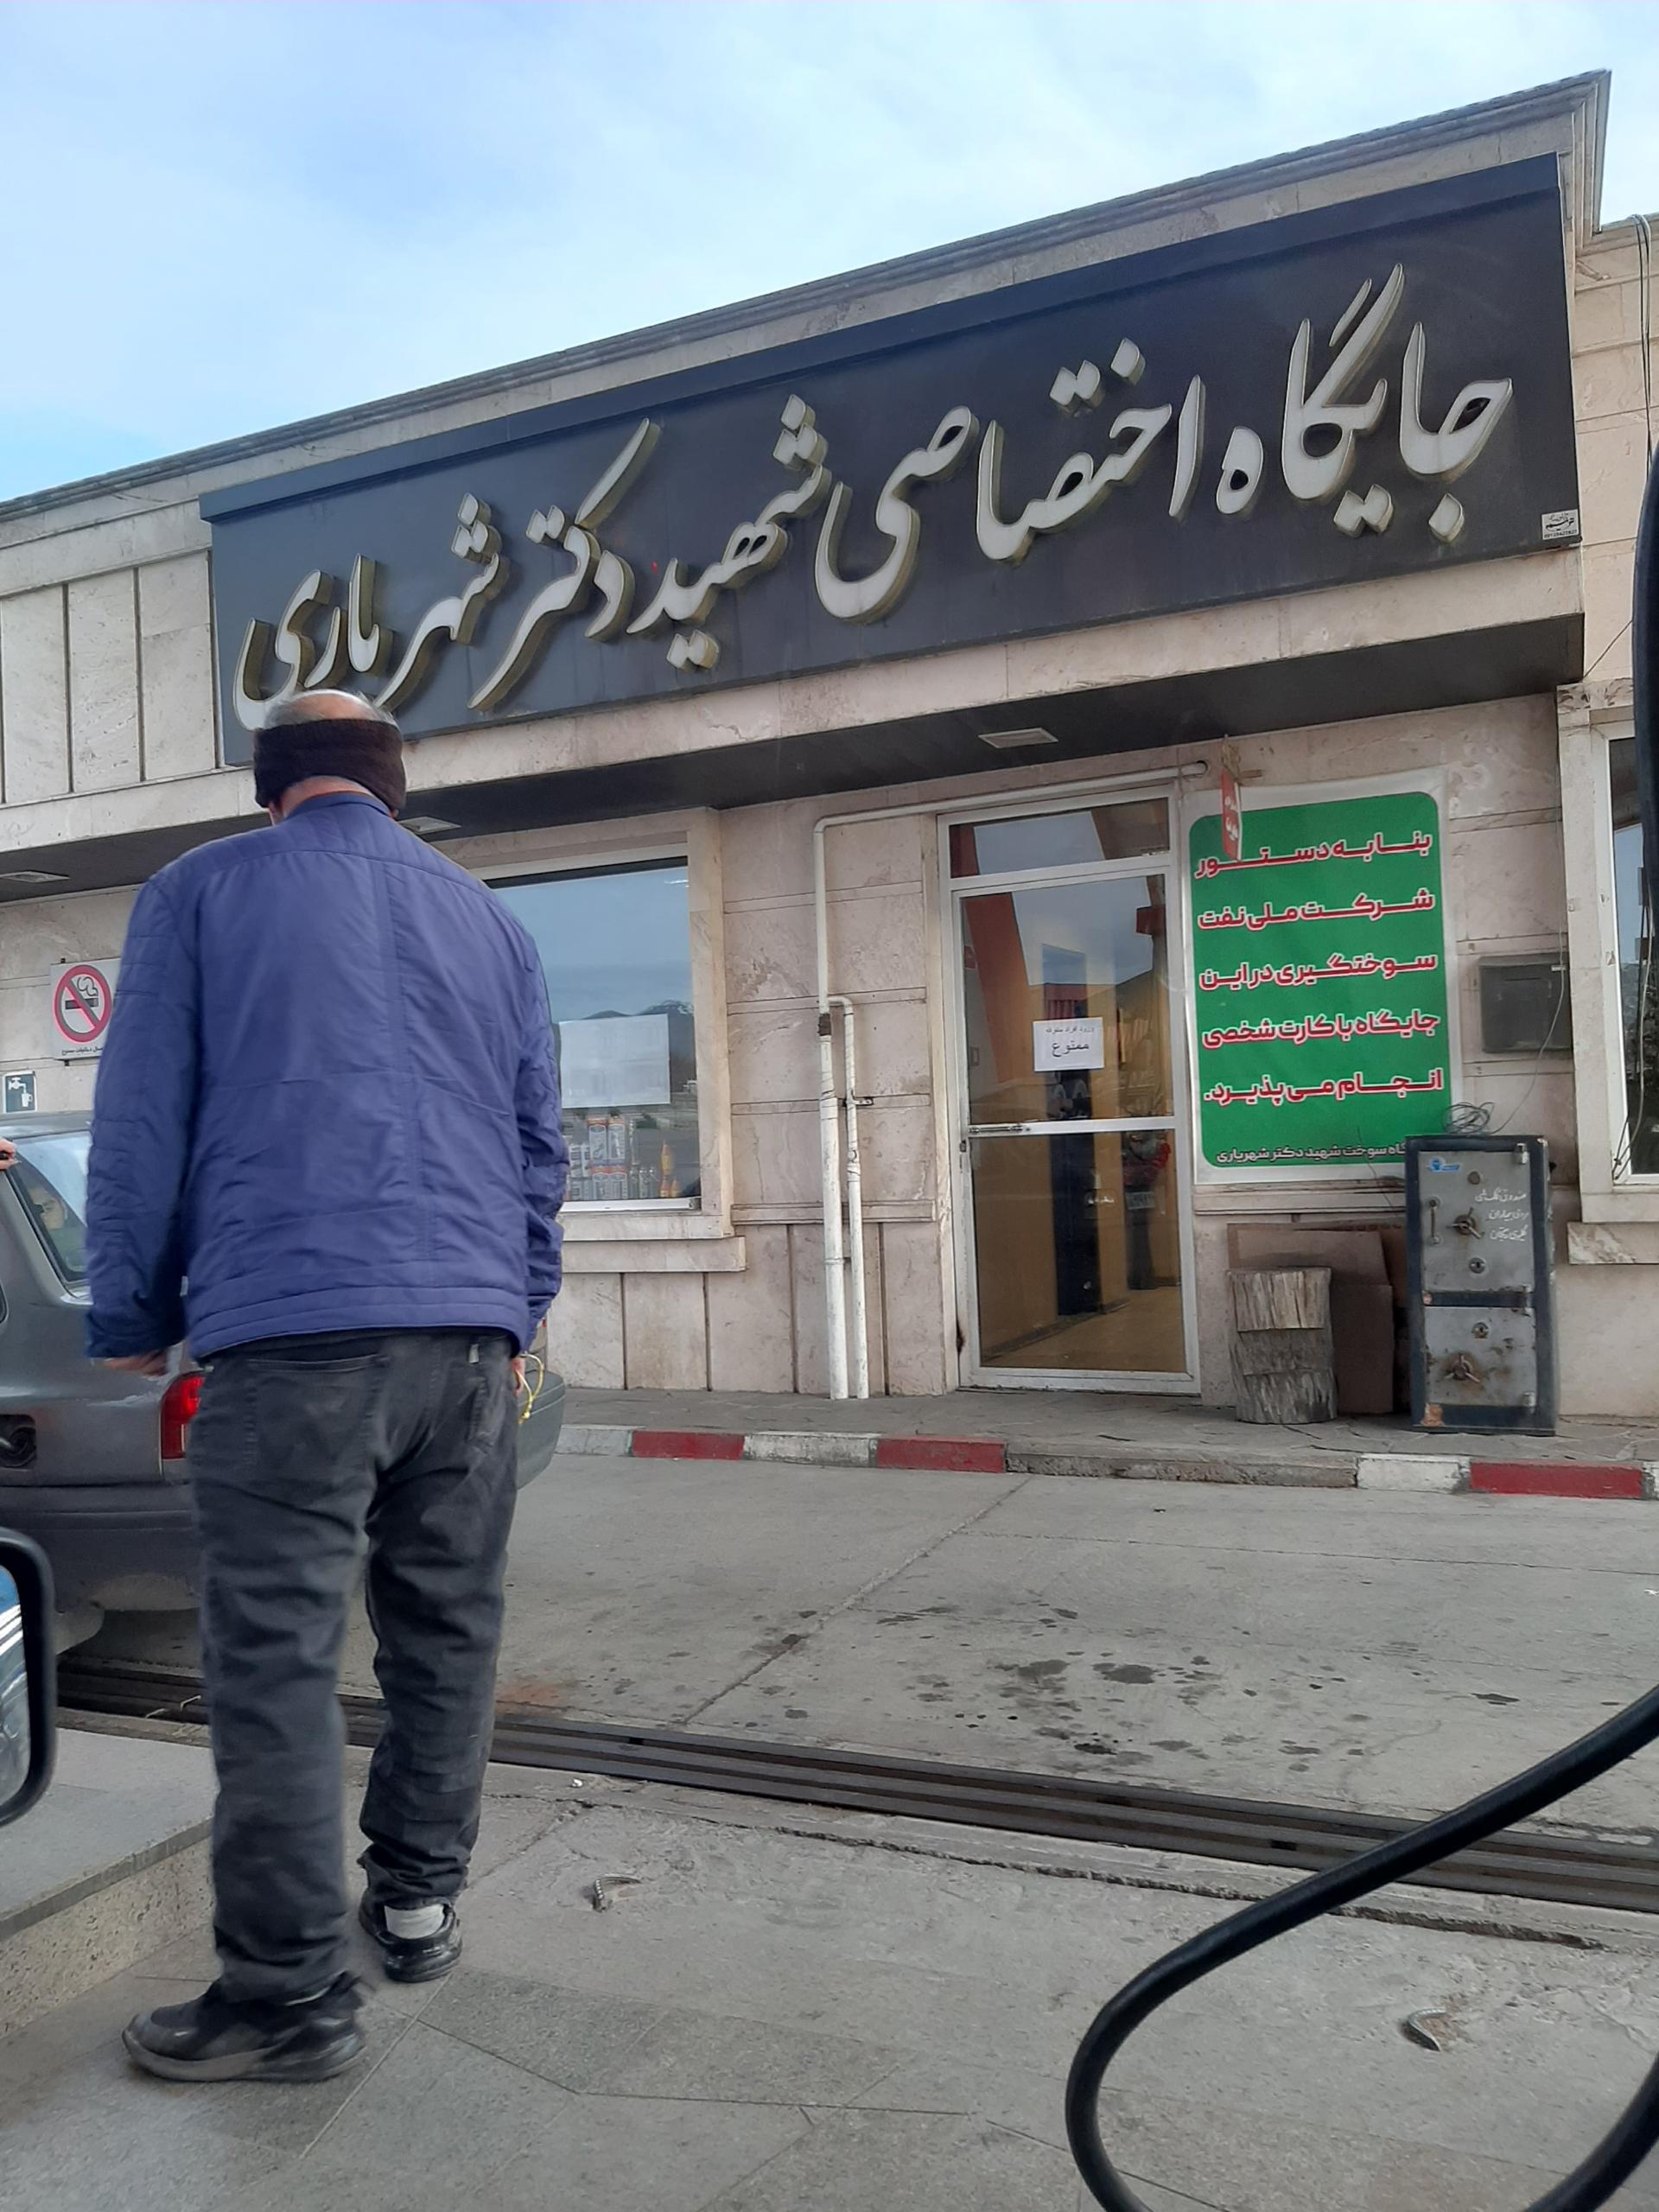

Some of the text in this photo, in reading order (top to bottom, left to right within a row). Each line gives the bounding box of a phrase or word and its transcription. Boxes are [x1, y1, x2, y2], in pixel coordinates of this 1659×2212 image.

[1217, 264, 1512, 543] جایگاه
[815, 337, 1205, 623] اختصاصی
[626, 394, 831, 670] شهید
[468, 417, 662, 712] دکتر
[1194, 842, 1329, 879] دستور
[1198, 887, 1434, 931] شرکت ملی نفت
[1199, 953, 1438, 992] سوختگیری در این
[1202, 1008, 1440, 1049] جایگاه با کارت شخصی
[1052, 1039, 1090, 1058] ممنوع
[1337, 1067, 1443, 1100] انجام
[1217, 1148, 1270, 1164] شهریاری
[1270, 1147, 1304, 1161] دکتر
[1306, 1146, 1341, 1160] شهید
[1344, 1144, 1387, 1159] سوخت
